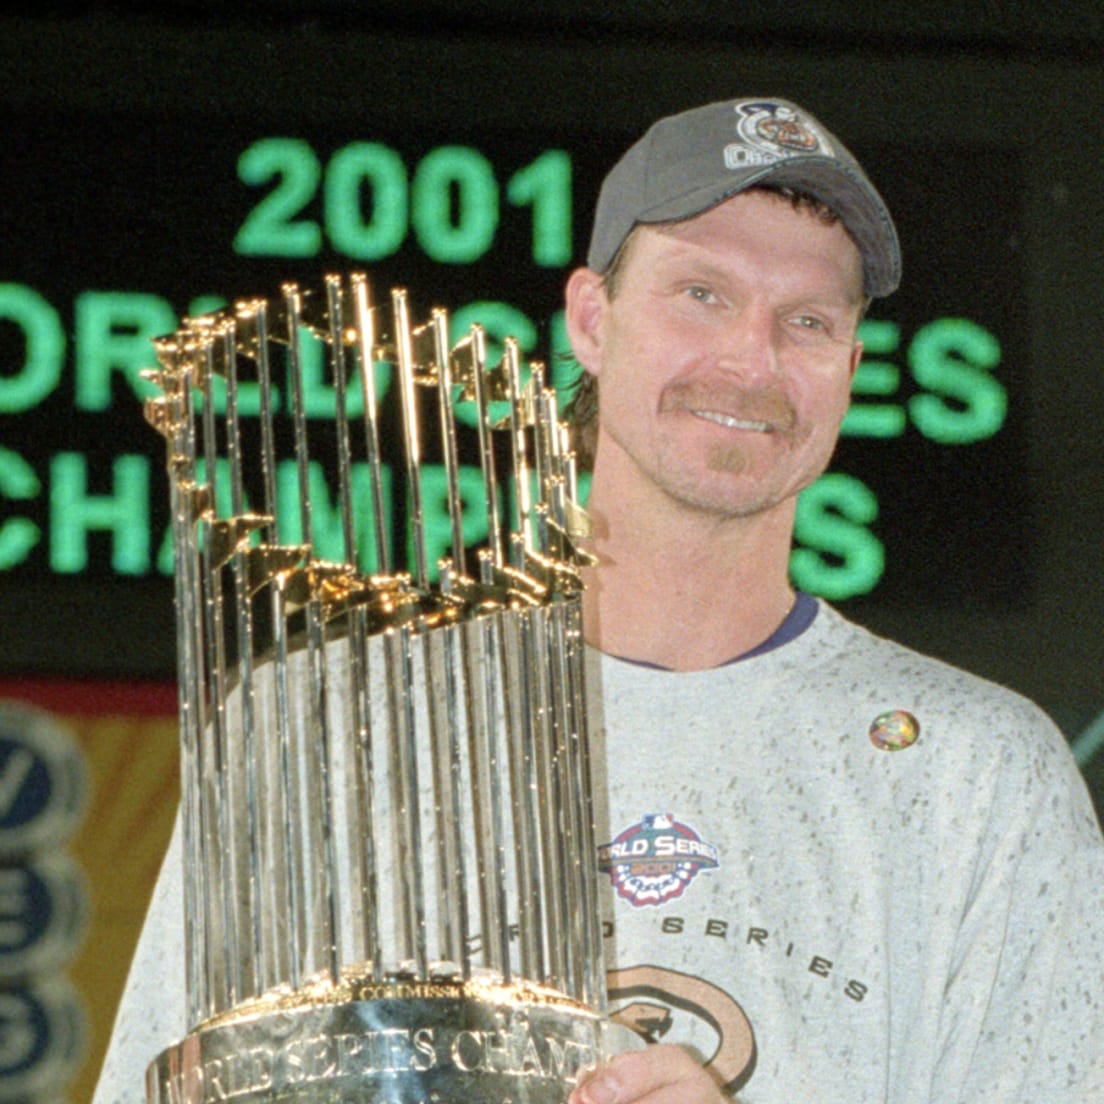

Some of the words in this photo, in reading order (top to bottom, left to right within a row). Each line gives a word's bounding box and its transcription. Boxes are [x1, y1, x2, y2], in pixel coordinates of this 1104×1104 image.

[232, 137, 573, 266] 2001
[661, 916, 869, 1003] SERIES
[284, 1026, 436, 1084] SERIES
